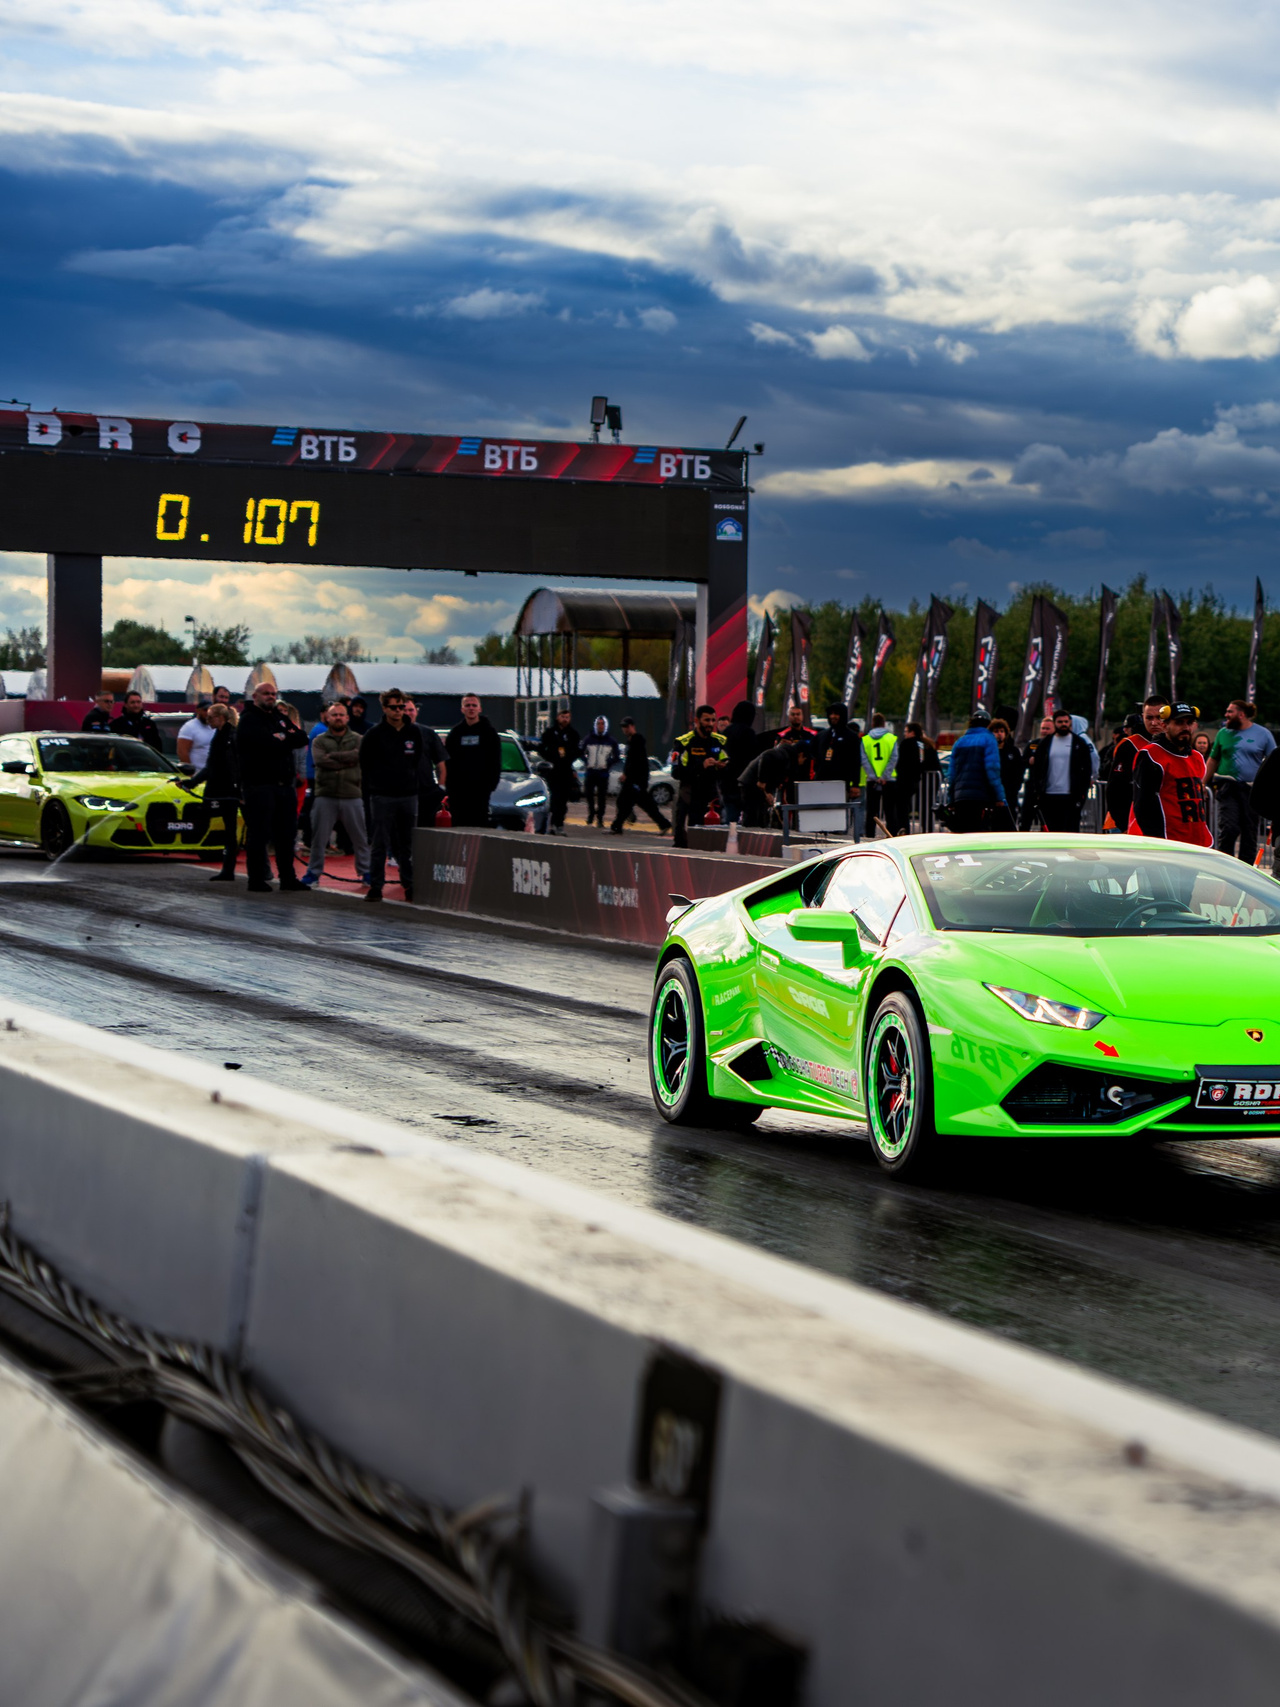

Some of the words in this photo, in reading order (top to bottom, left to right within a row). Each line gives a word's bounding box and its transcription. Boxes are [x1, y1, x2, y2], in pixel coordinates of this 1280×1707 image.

[301, 435, 357, 462] ВТБ
[484, 445, 538, 471] ВТБ
[660, 453, 711, 479] ВТБ
[873, 742, 883, 761] 1
[924, 854, 983, 868] 71
[512, 857, 550, 898] RDRC
